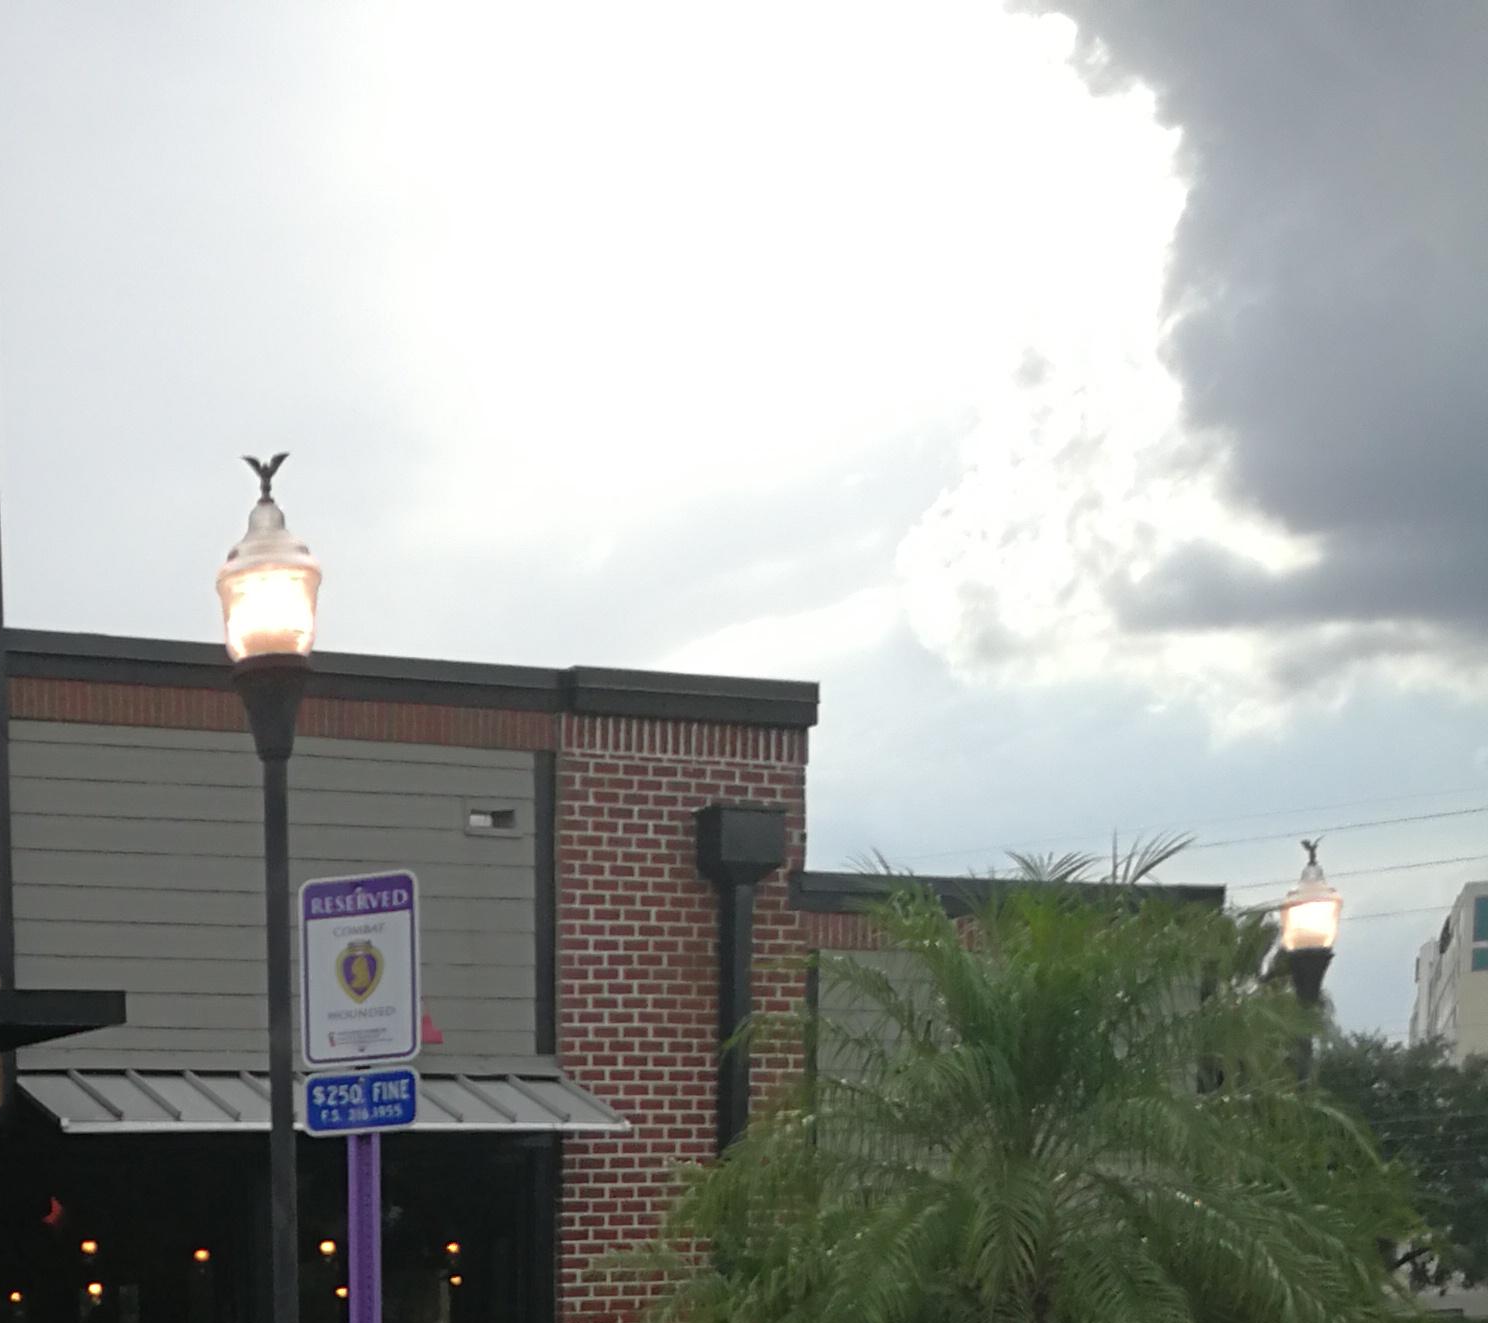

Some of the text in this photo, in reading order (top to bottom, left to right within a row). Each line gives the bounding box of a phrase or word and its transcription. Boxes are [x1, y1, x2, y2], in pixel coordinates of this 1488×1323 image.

[311, 888, 409, 914] RESERVED
[332, 922, 386, 937] COMBAT
[312, 1079, 410, 1106] $250 FINE
